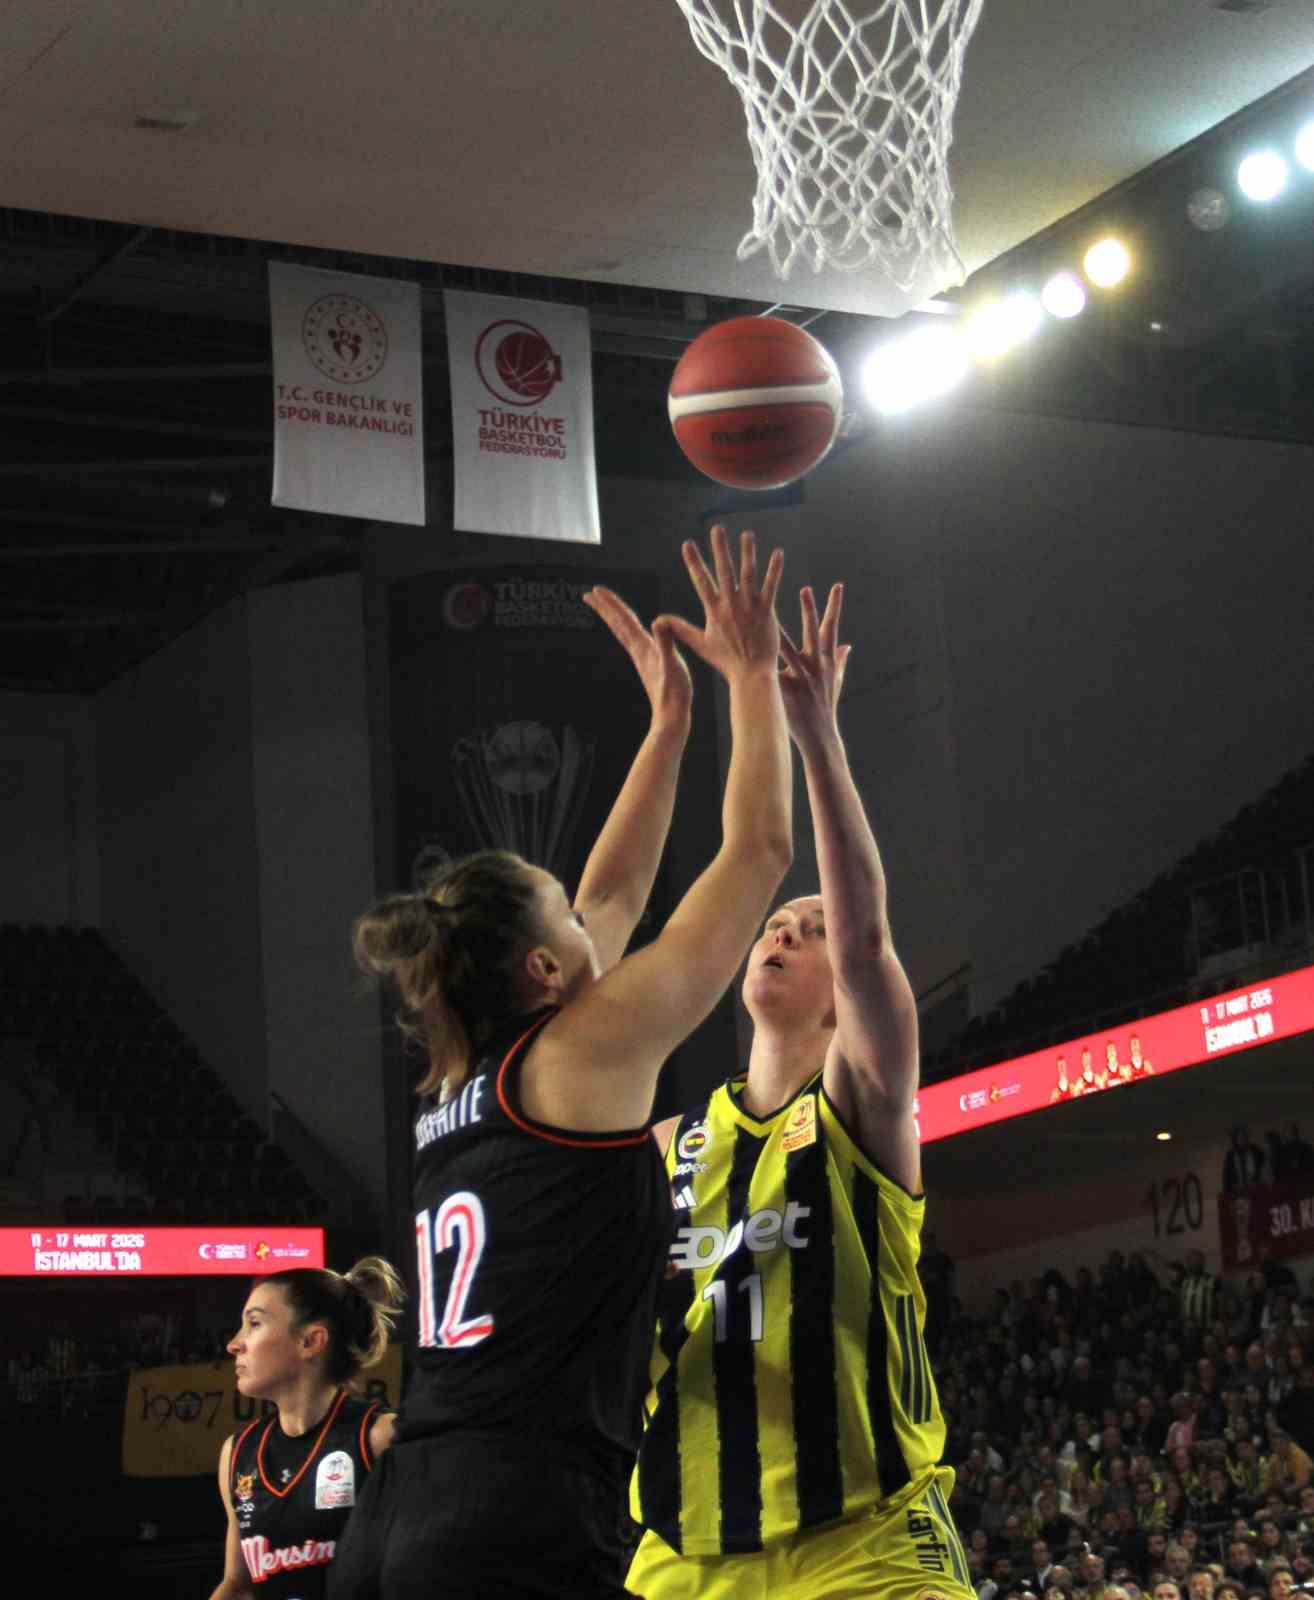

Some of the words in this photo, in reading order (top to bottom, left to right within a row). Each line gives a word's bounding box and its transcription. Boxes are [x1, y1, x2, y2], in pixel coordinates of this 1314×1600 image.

[277, 384, 308, 401] T.C.
[313, 390, 386, 413] GENÇLİK
[392, 400, 412, 417] VE
[277, 405, 320, 424] SPOR
[478, 407, 565, 434] TÜRKİYE
[478, 427, 567, 448] BASKETBOL
[1145, 1172, 1203, 1238] 120
[31, 1233, 41, 1247] 11
[57, 1233, 68, 1247] 17
[73, 1233, 107, 1247] MART
[111, 1233, 145, 1247] 2026
[415, 1191, 495, 1348] 12
[703, 1273, 764, 1343] 11
[240, 1535, 338, 1584] Mersin
